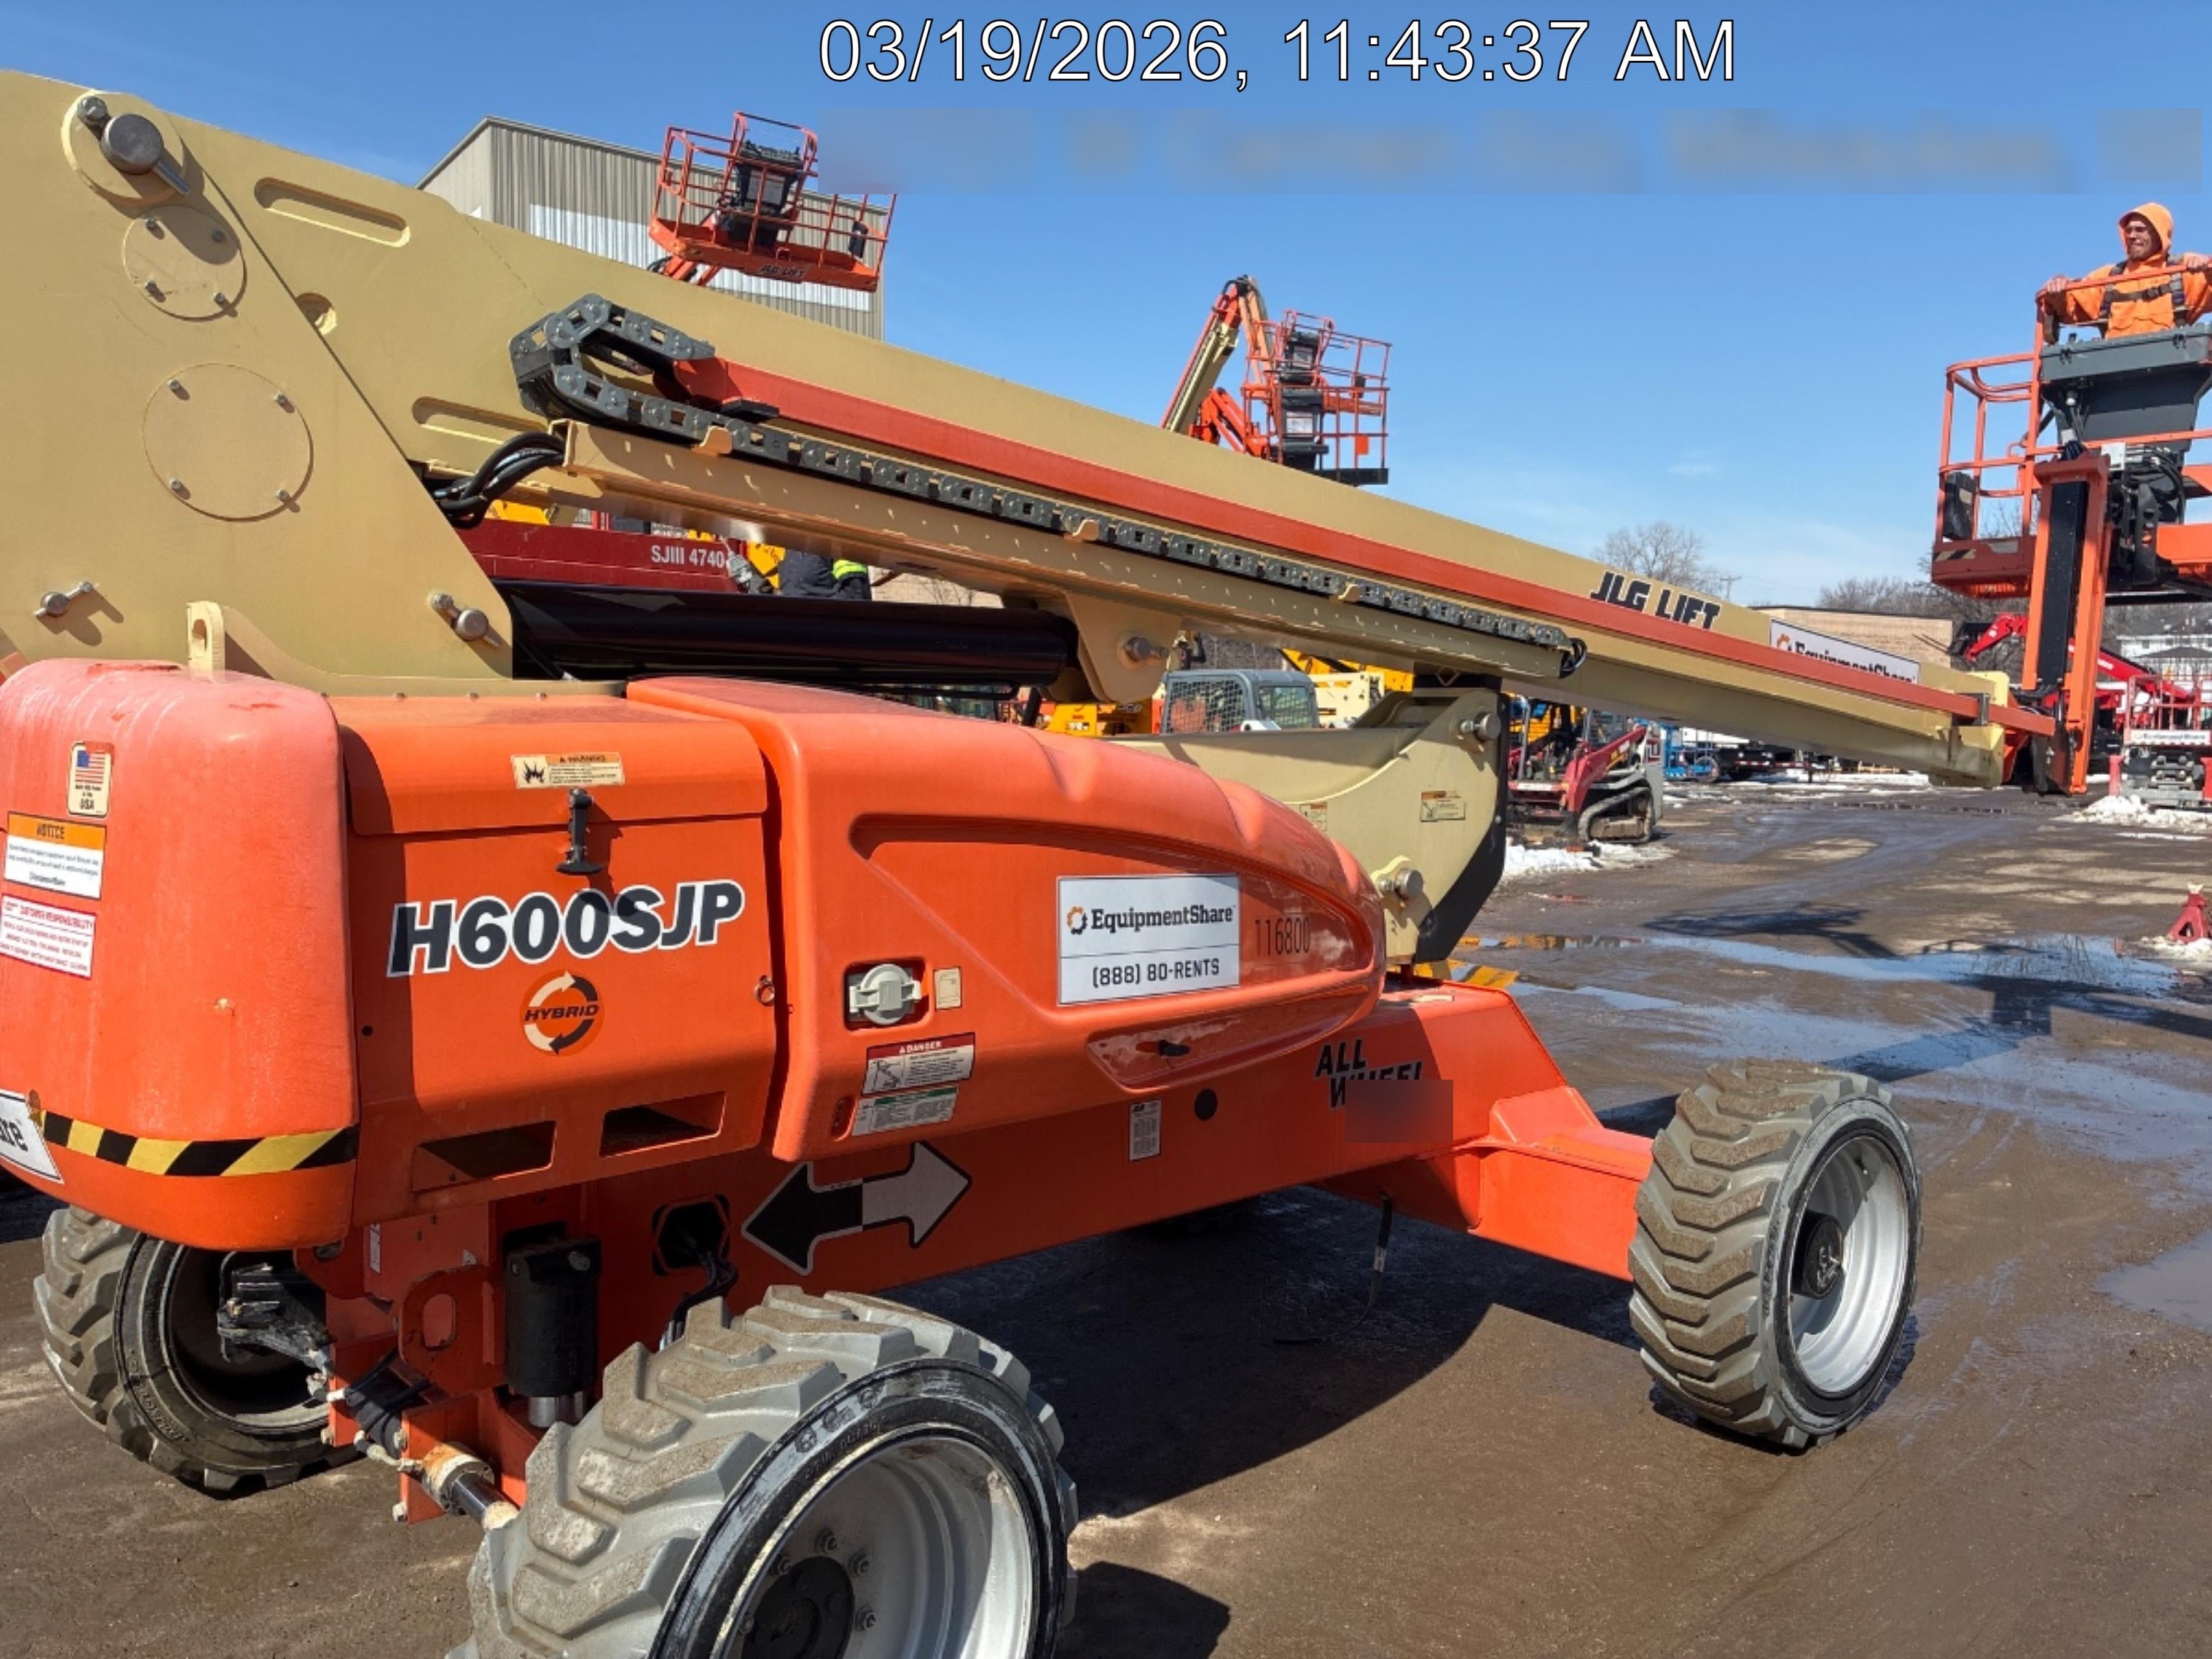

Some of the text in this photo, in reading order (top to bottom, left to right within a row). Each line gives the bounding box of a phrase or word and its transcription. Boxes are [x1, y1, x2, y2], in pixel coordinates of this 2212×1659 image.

[689, 548, 725, 568] 4740
[1589, 570, 1721, 630] JLG LIFT
[36, 822, 65, 840] NOTICE
[386, 879, 745, 978] H600SJP
[1091, 904, 1234, 933] EquipmentShare
[1092, 959, 1220, 989] (888) 80-RENTS
[524, 1004, 599, 1022] HYBRID
[906, 1041, 943, 1054] DANGER
[1314, 1038, 1367, 1078] ALL
